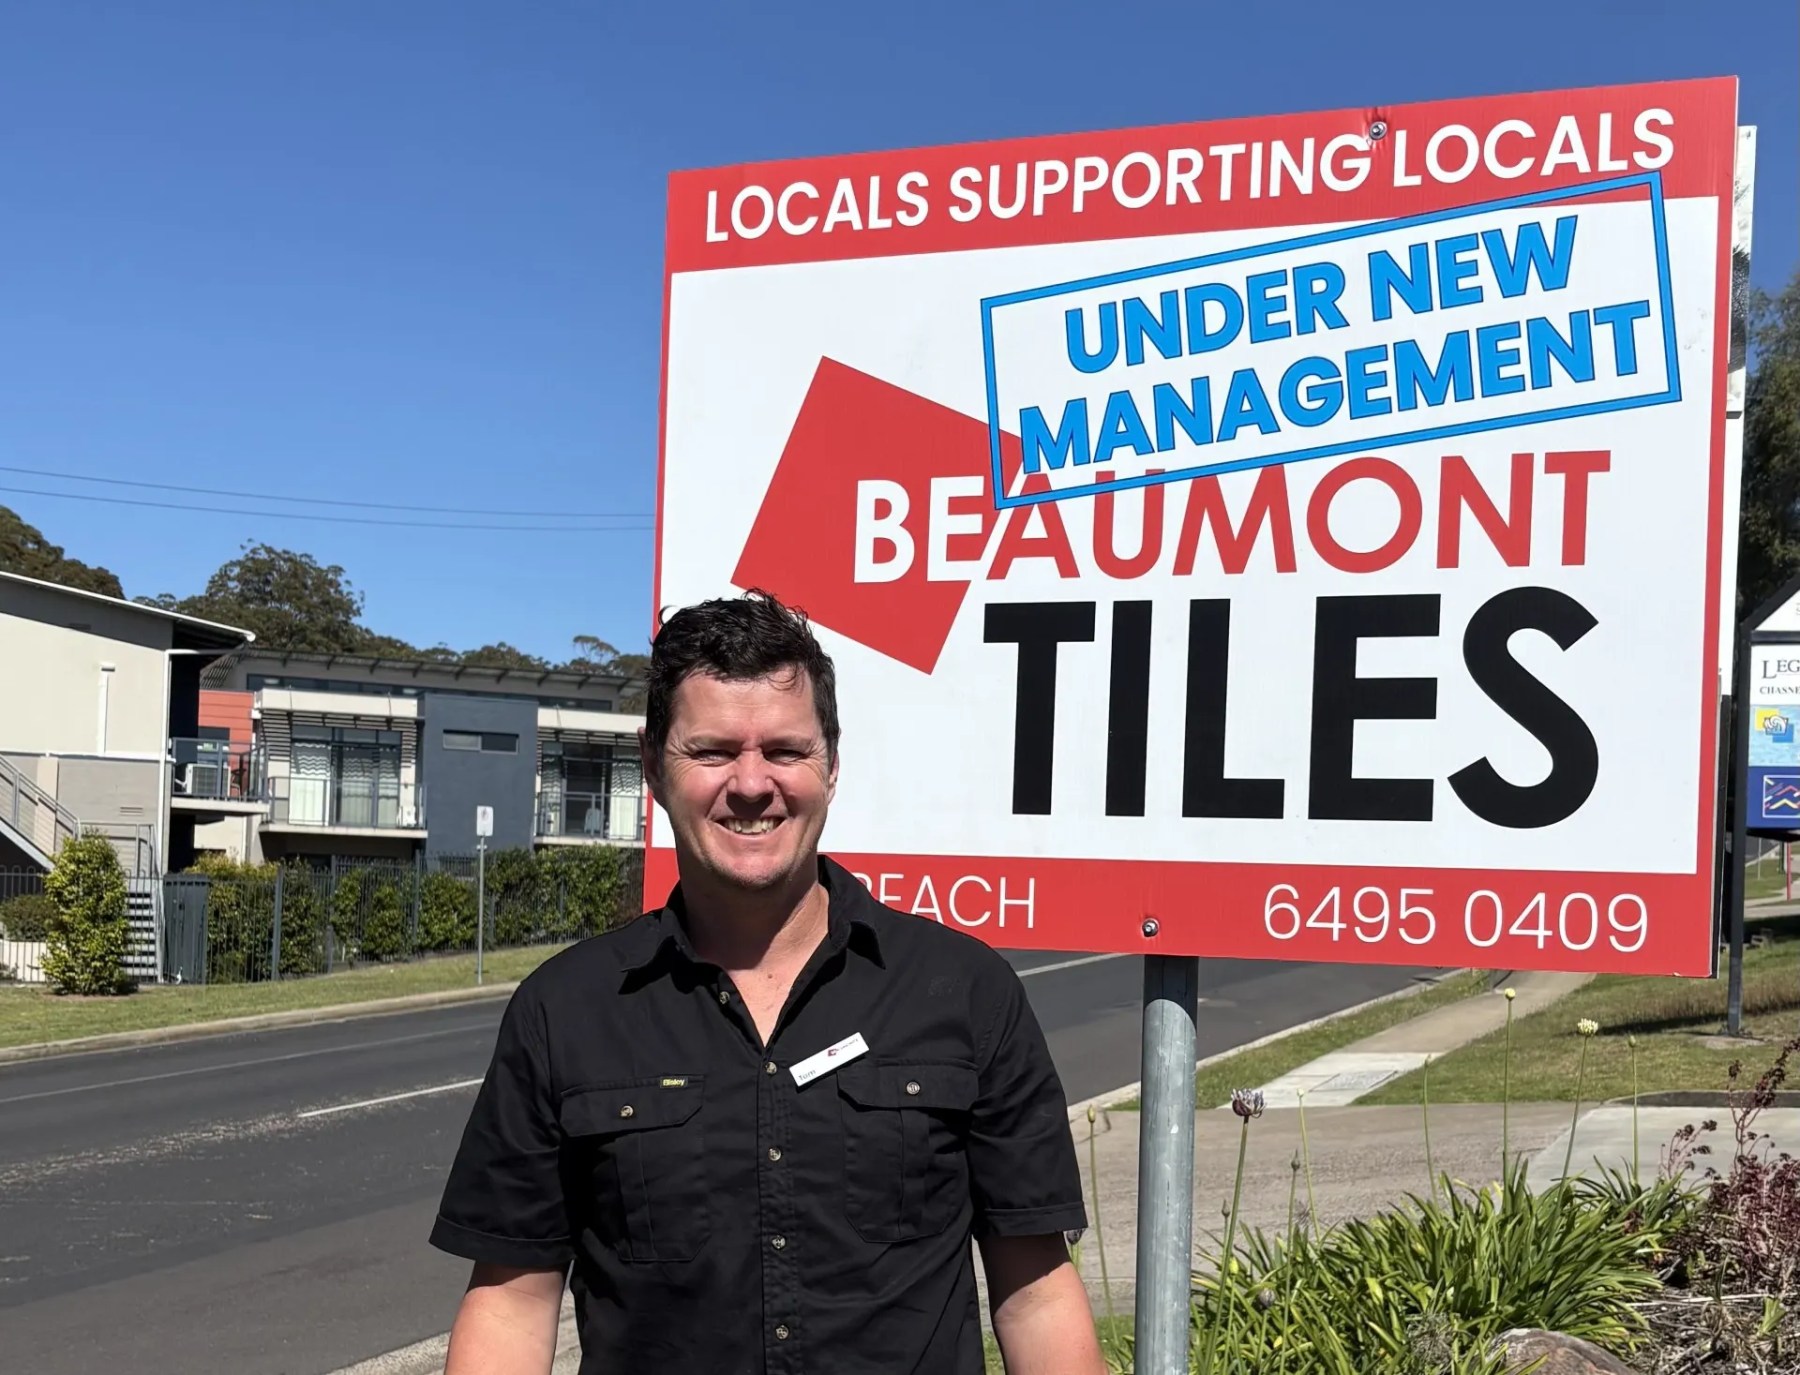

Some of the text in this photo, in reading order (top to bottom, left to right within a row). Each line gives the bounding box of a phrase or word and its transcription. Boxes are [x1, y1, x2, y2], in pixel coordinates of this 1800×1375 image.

[706, 108, 1674, 243] LOCALS SUPPORTING LOCALS
[1065, 214, 1578, 374] UNDER NEW
[1019, 300, 1650, 474] MANAGEMENT
[853, 450, 1611, 583] BEAUMONT
[983, 586, 1600, 829] TILES
[1263, 883, 1436, 945] 6495
[1464, 889, 1648, 953] 0409
[798, 1070, 817, 1082] Tom
